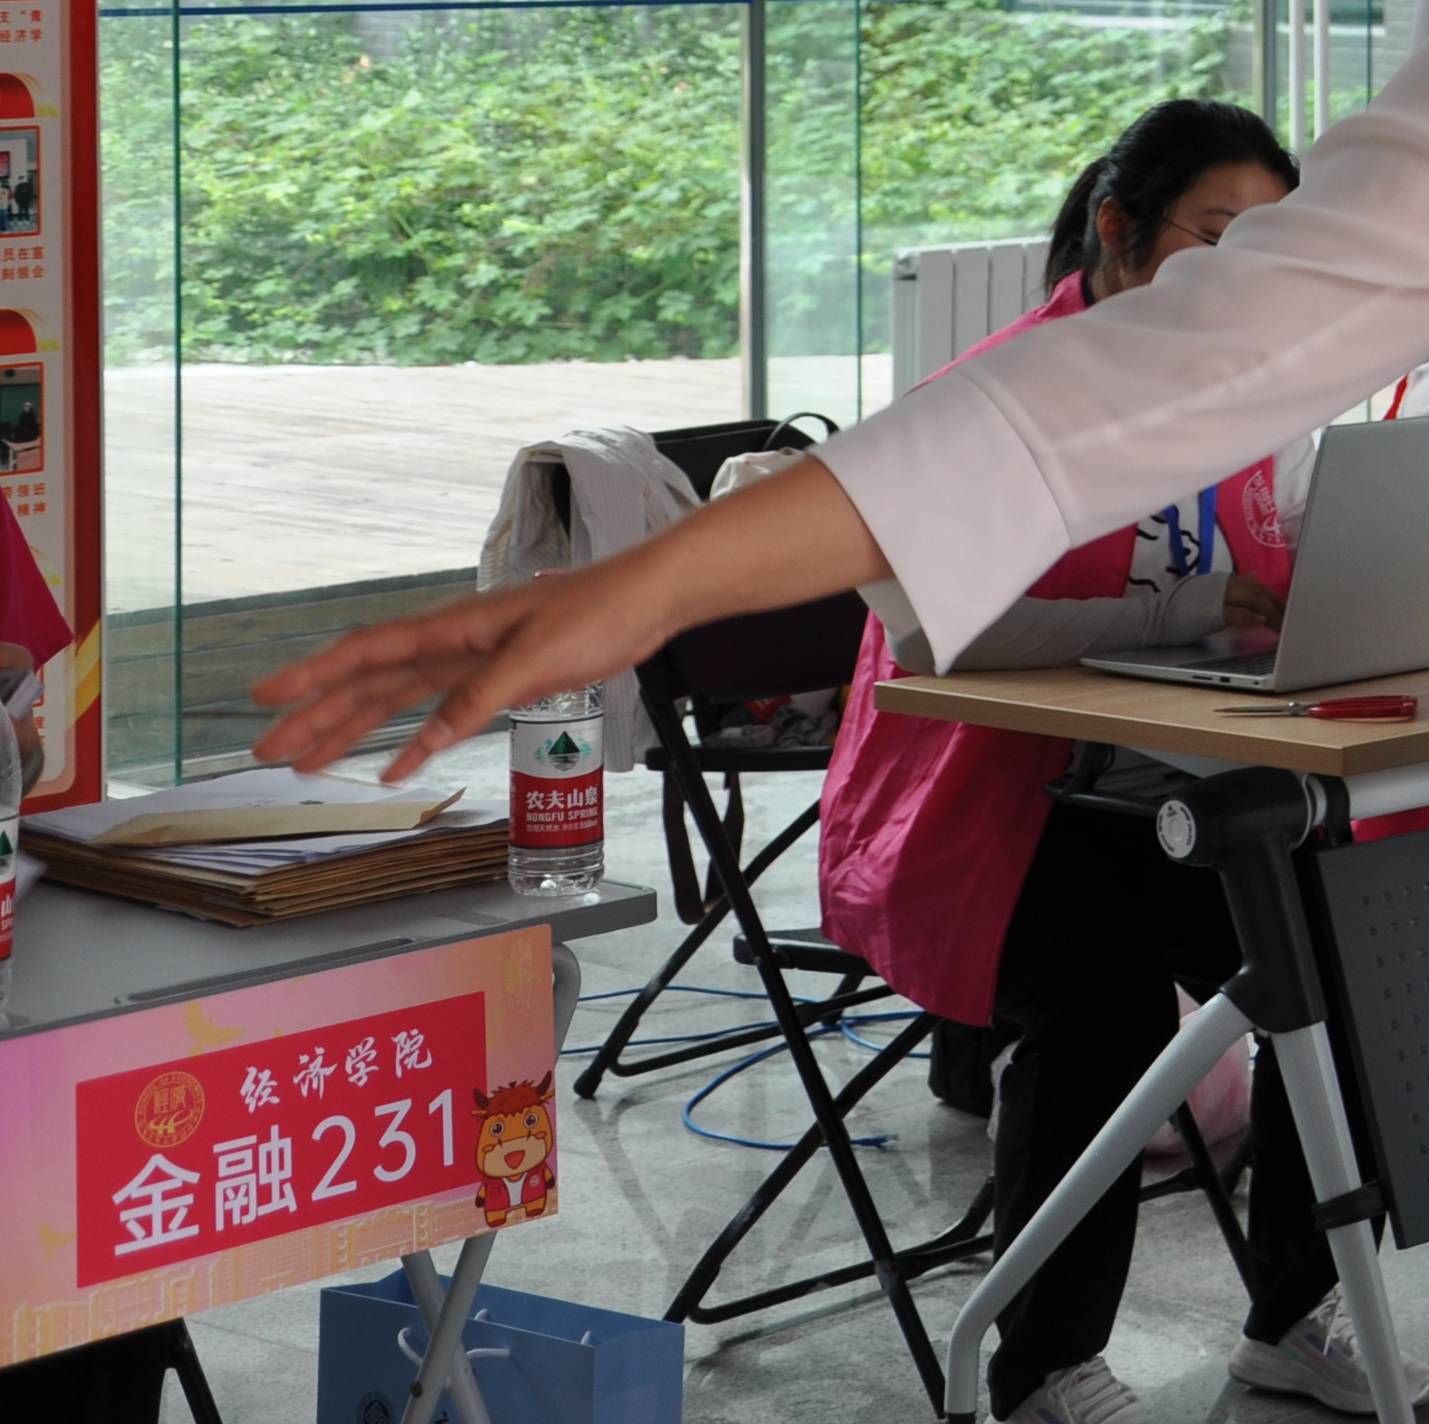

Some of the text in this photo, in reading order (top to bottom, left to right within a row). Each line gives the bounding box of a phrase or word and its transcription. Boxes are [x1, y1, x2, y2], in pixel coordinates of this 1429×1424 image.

[526, 786, 598, 810] 农夫山泉
[527, 807, 597, 823] NONGFU SPRING
[240, 1029, 432, 1113] 经济学院
[112, 1088, 454, 1256] 金融231
